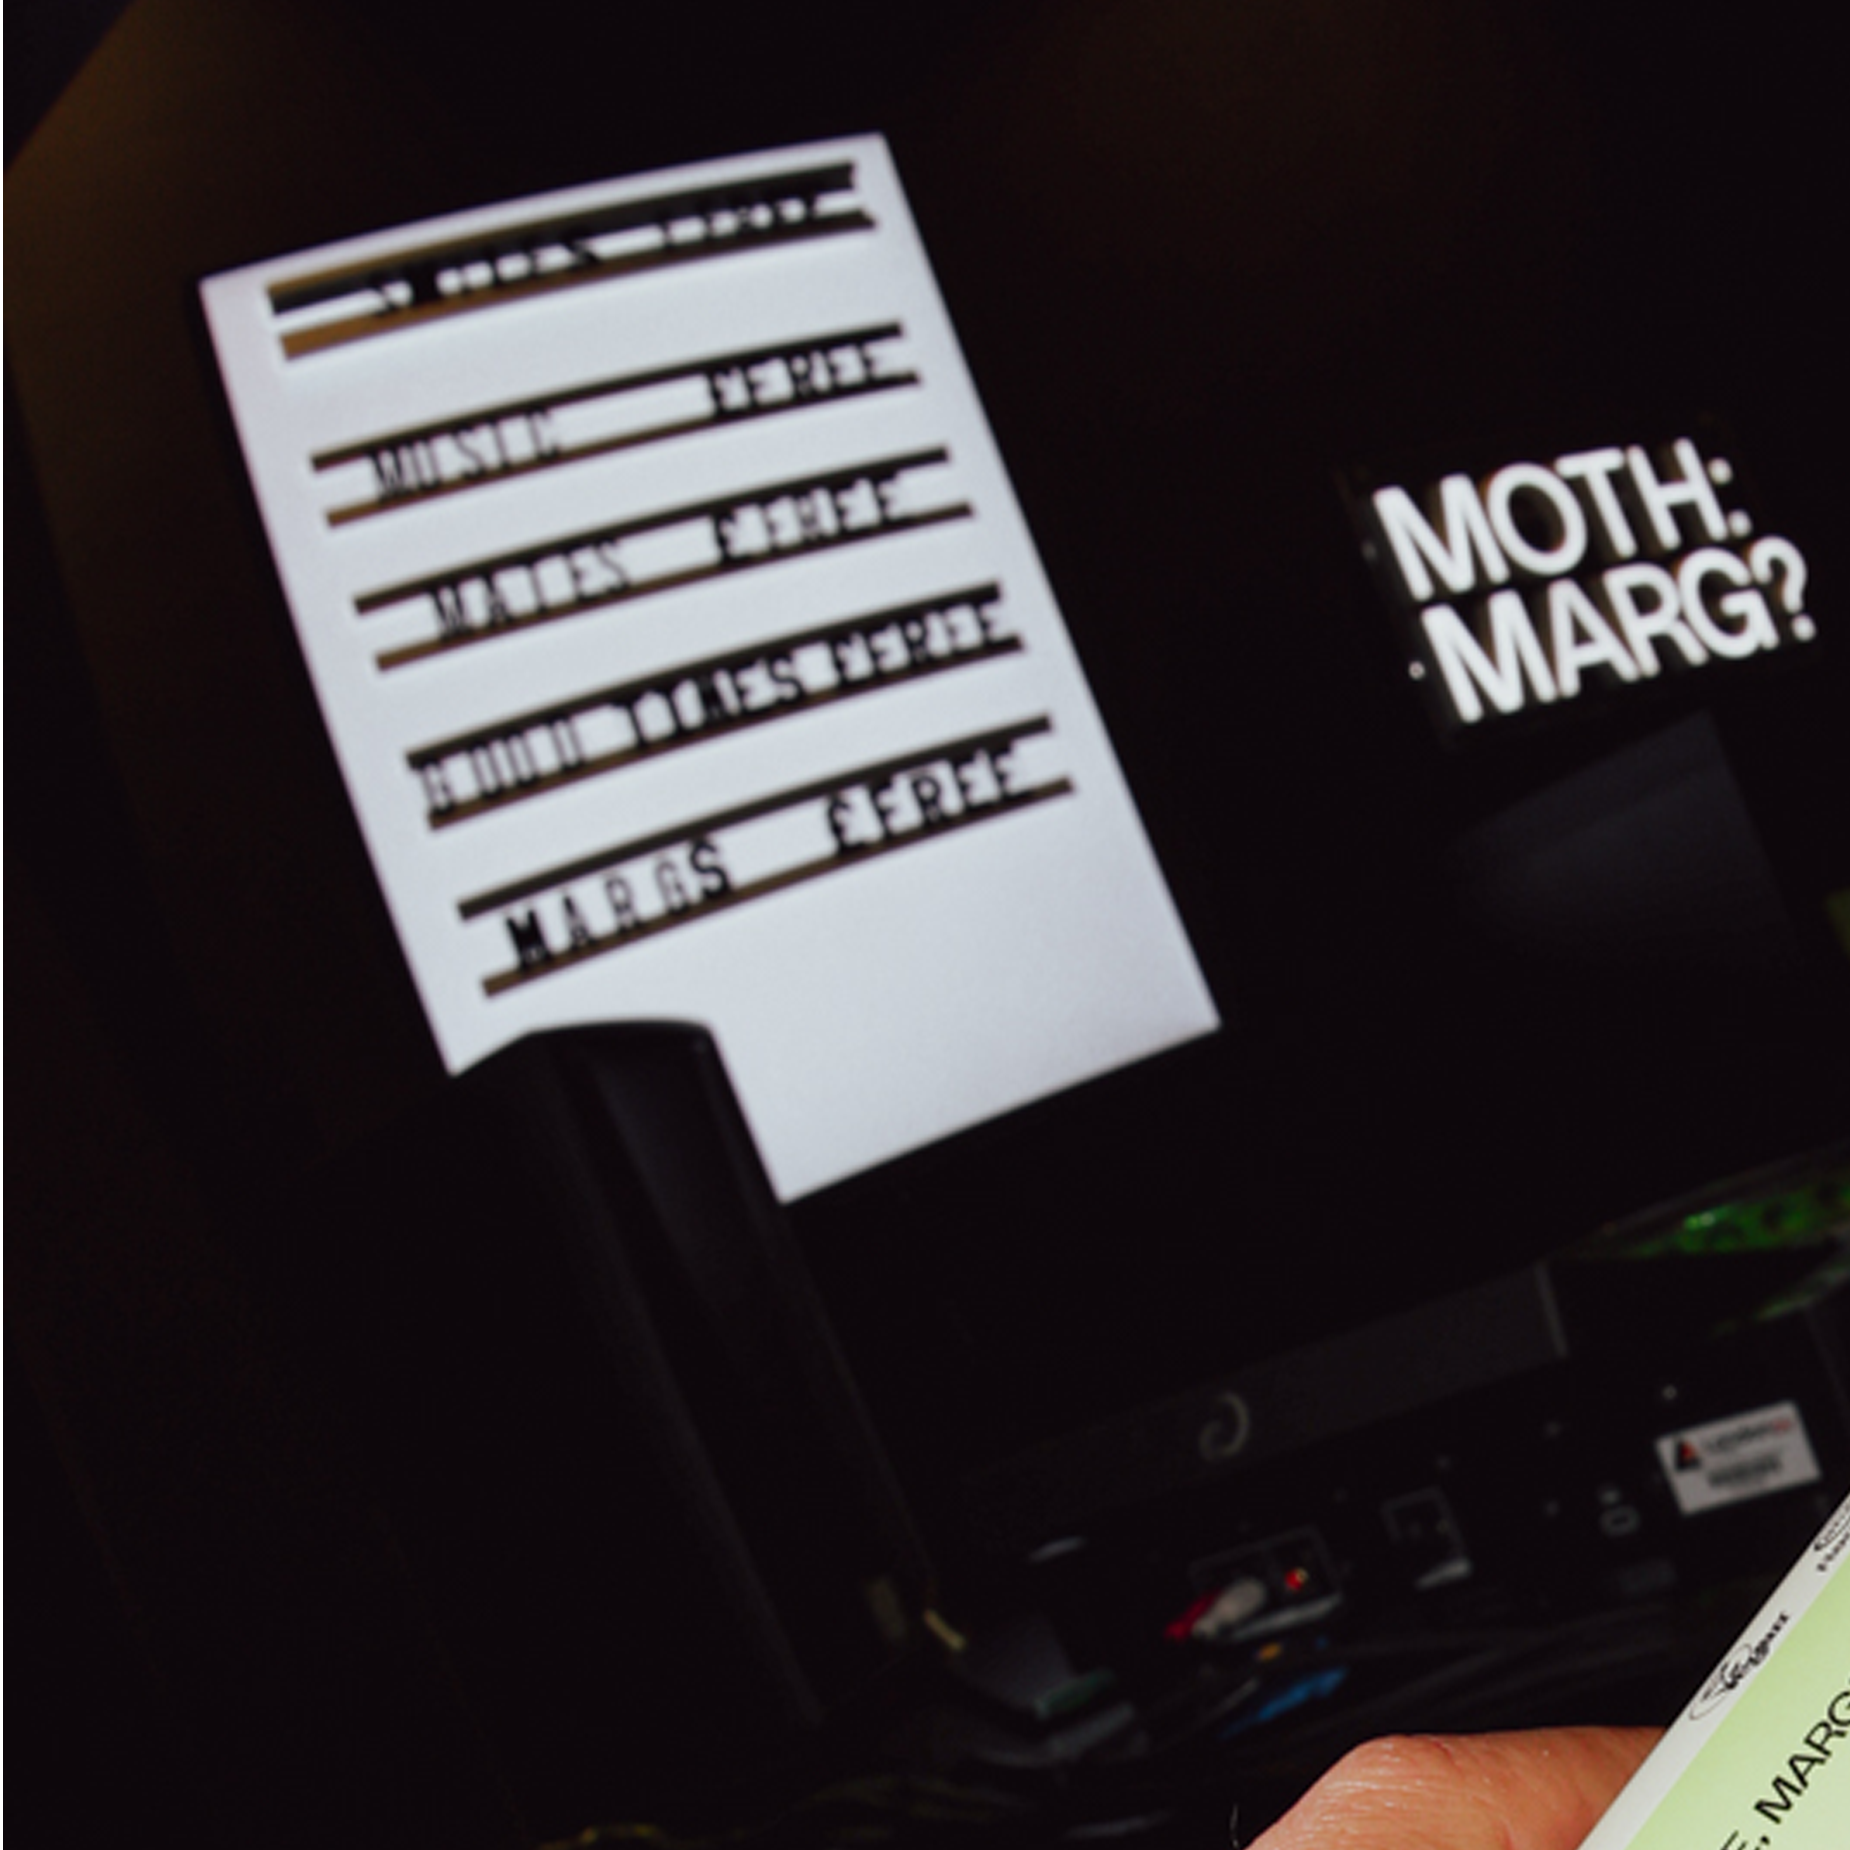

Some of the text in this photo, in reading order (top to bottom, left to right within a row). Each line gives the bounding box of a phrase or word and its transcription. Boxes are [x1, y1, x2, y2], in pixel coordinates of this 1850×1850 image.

[1373, 437, 1752, 602] MOTH:
[1421, 536, 1816, 723] MARG?
[505, 838, 728, 975] MARGS
